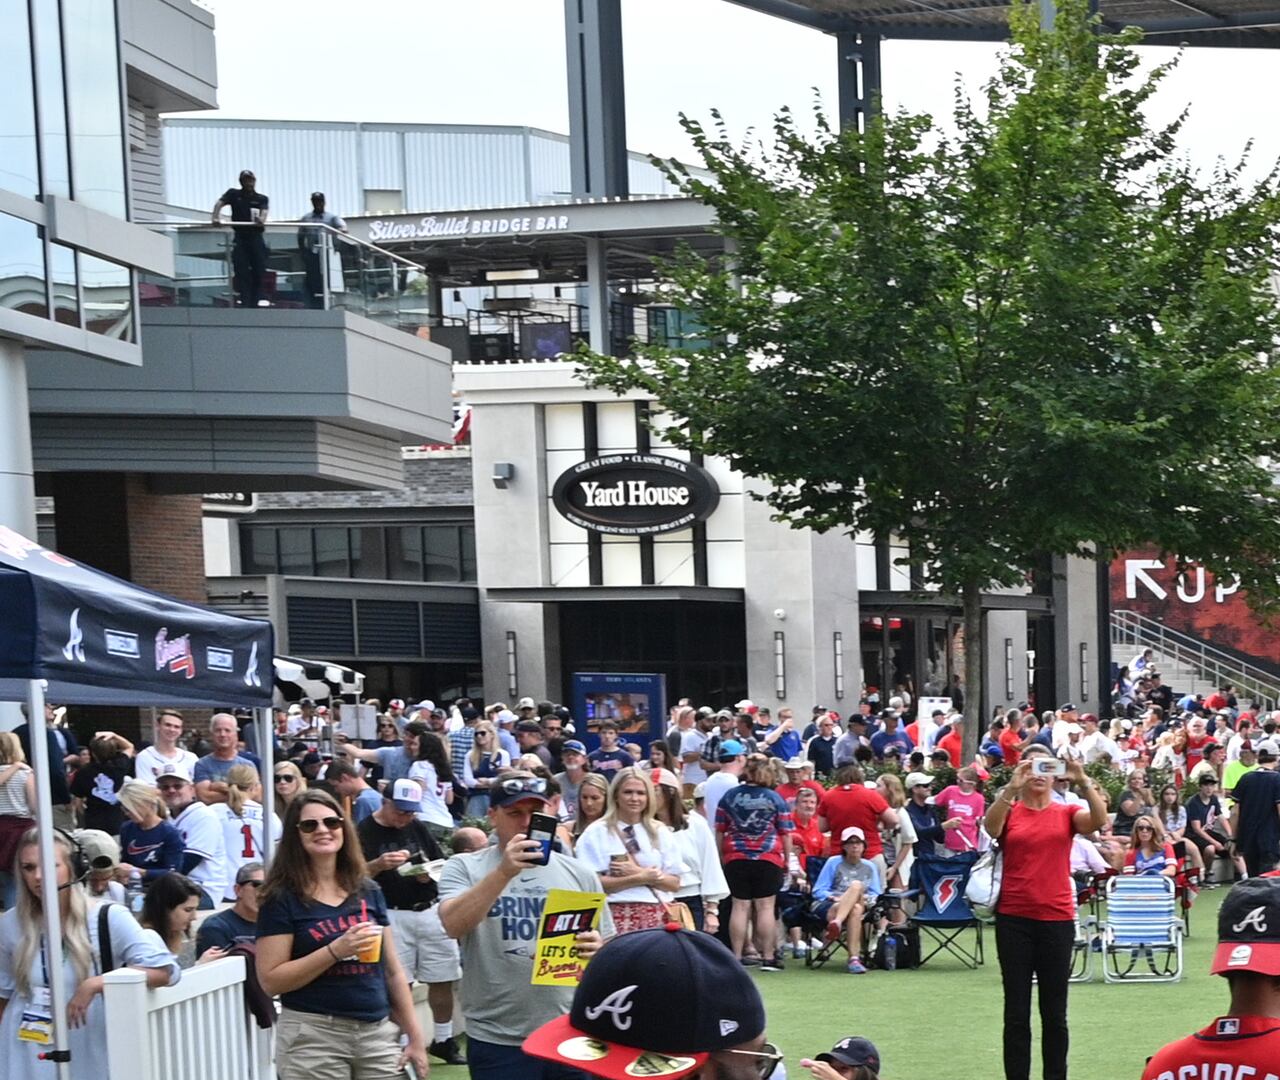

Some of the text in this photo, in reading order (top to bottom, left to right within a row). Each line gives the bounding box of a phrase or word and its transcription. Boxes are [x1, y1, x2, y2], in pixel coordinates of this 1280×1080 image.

[369, 216, 569, 240] Silver Bullet BRIDGE BAR
[579, 480, 690, 507] Yard House
[240, 824, 255, 858] 1
[487, 896, 548, 918] BRIN
[1232, 905, 1268, 933] A
[585, 984, 640, 1031] A
